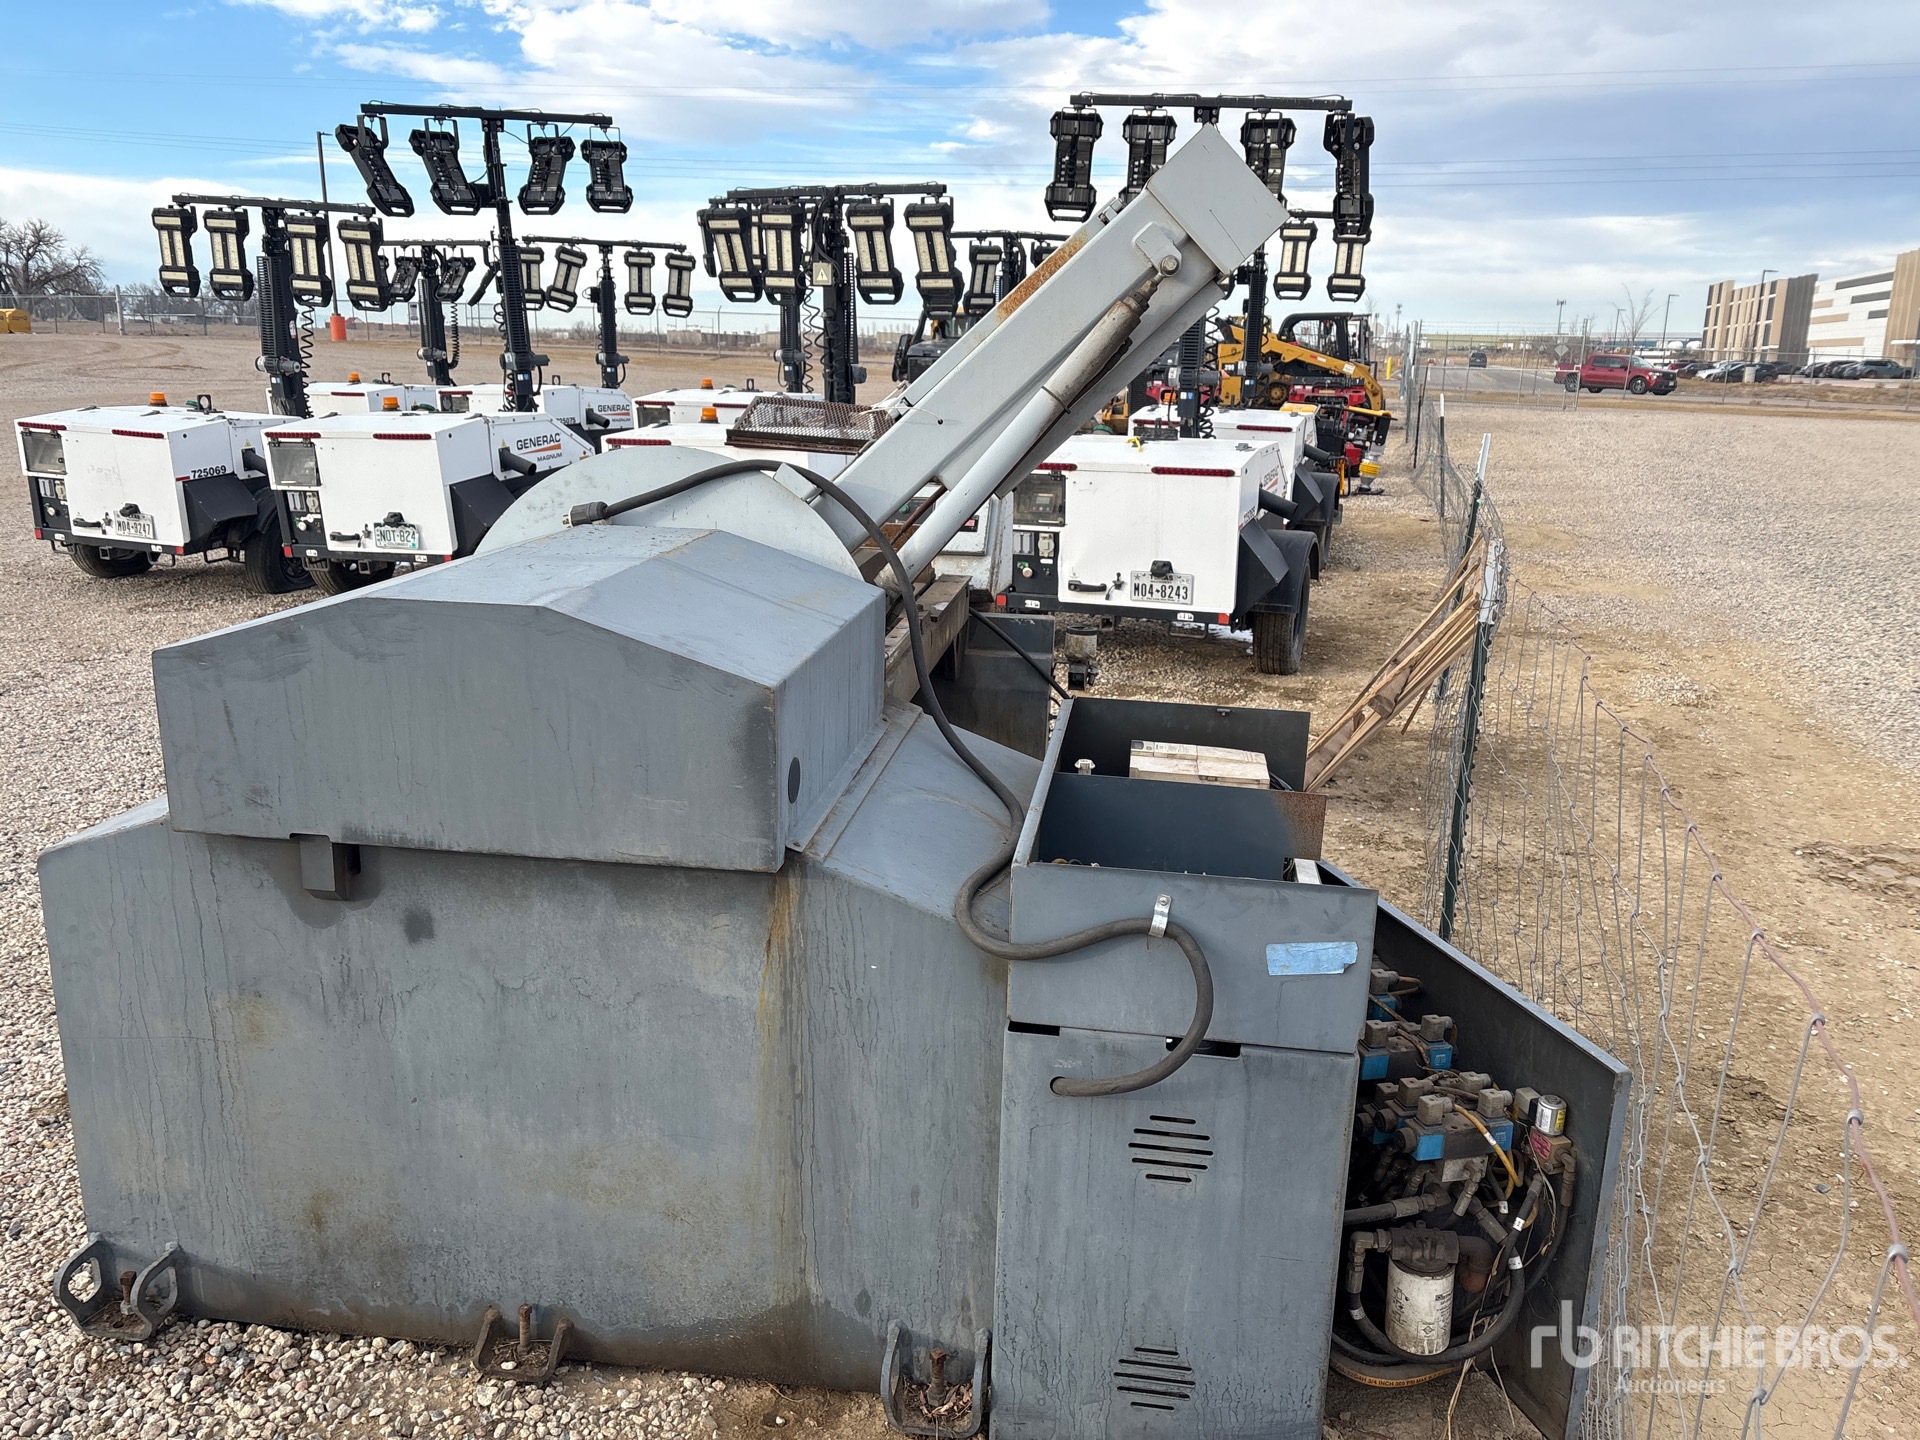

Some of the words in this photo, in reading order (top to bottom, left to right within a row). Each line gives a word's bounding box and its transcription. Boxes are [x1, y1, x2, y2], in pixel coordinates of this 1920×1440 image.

[597, 404, 631, 412] GENERAC
[516, 432, 561, 450] GENERAC
[537, 452, 563, 462] MAGNUM
[191, 465, 227, 479] 725069
[1378, 1379, 1394, 1387] INCH
